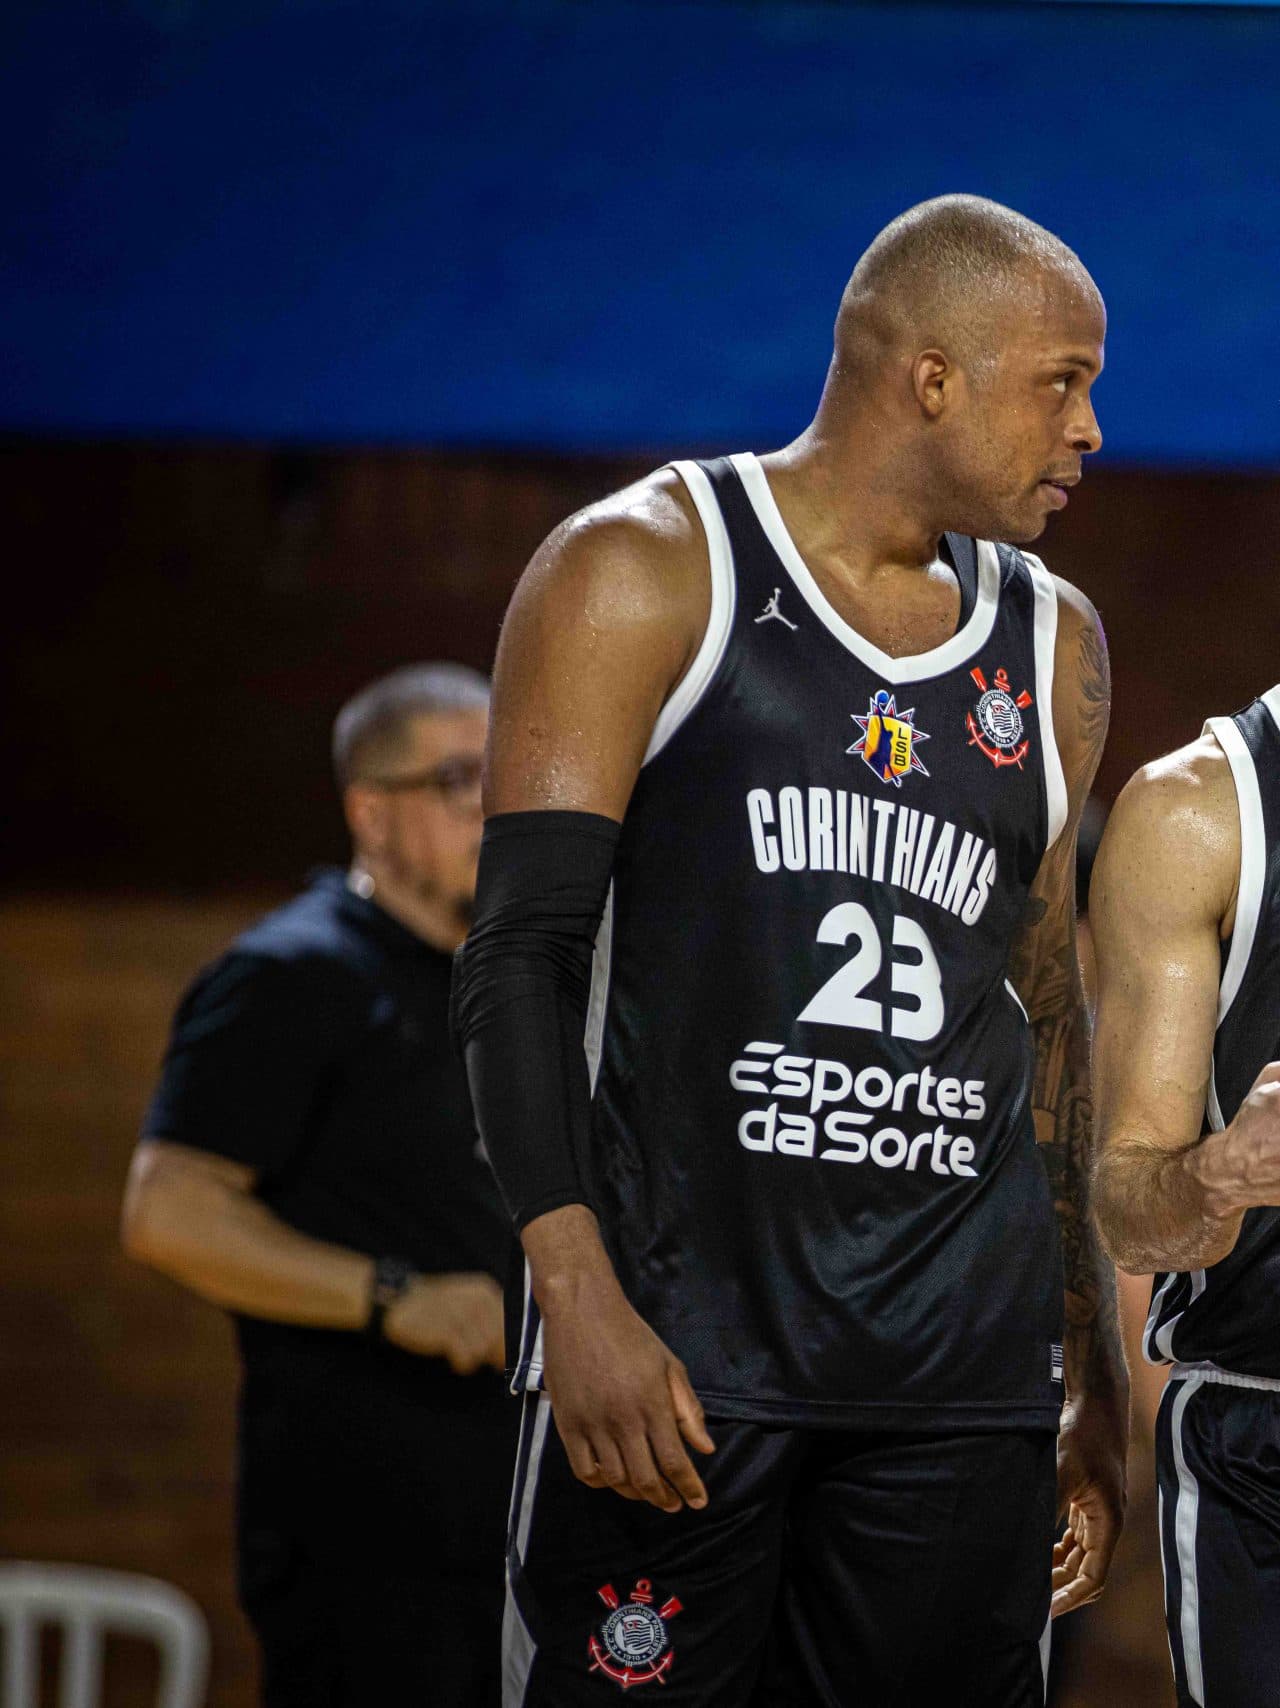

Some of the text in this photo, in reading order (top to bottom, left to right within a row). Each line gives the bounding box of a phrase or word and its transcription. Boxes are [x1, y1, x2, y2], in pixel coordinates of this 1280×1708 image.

[894, 727, 908, 767] LSB
[746, 786, 997, 926] CORINTHIANS
[796, 902, 945, 1042] 23
[729, 1041, 987, 1121] Esportes
